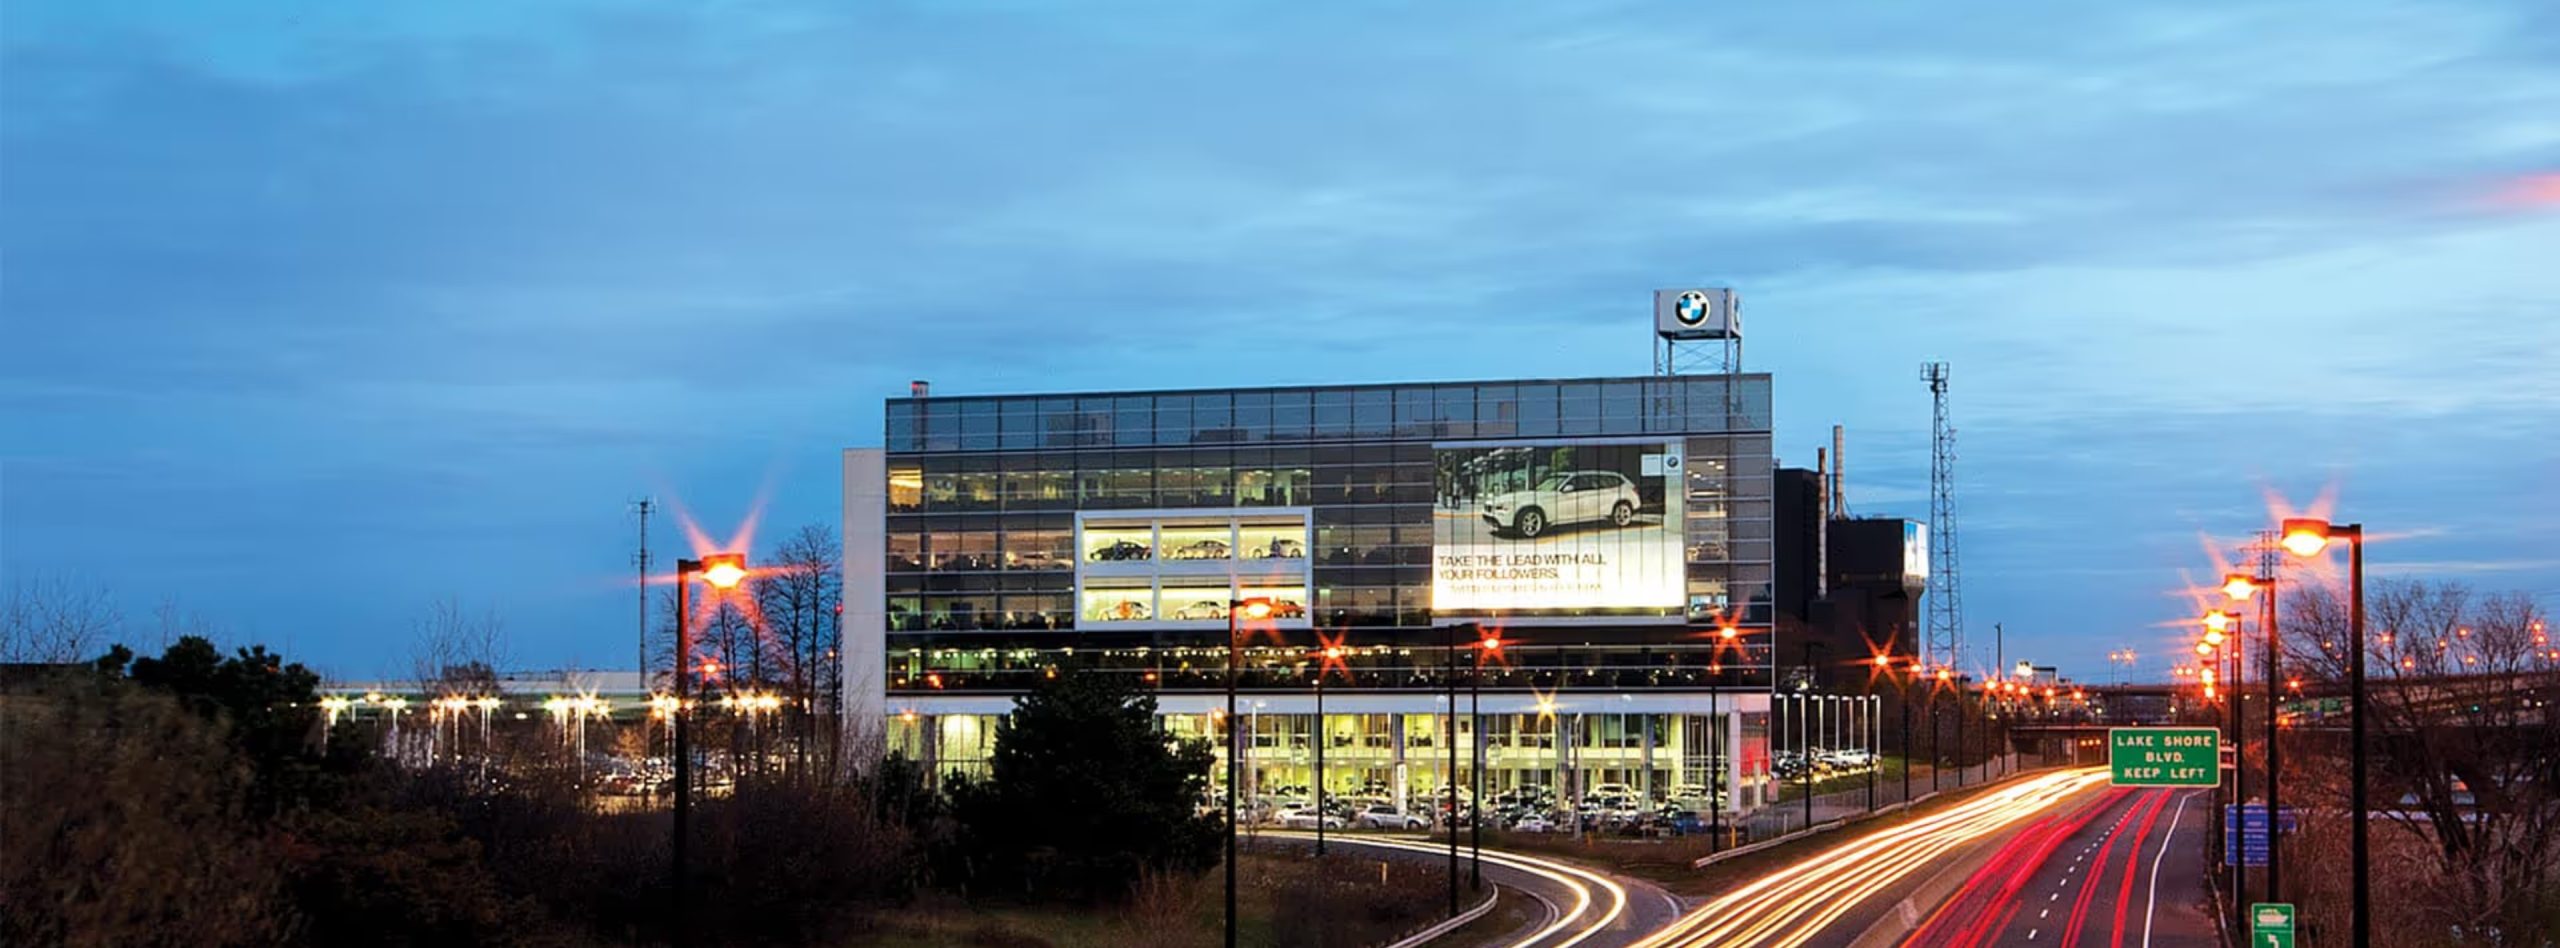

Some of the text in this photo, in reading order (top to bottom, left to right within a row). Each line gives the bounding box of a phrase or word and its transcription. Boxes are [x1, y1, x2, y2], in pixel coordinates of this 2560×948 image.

[1439, 553, 1606, 567] TAKE THE LEAD WITH ALL
[1439, 568, 1559, 580] YOUR FOLLOWERS.
[2117, 735, 2212, 747] LAKE SHORE
[2145, 751, 2185, 762] BLVD.
[2124, 767, 2206, 779] KEEP LEFT
